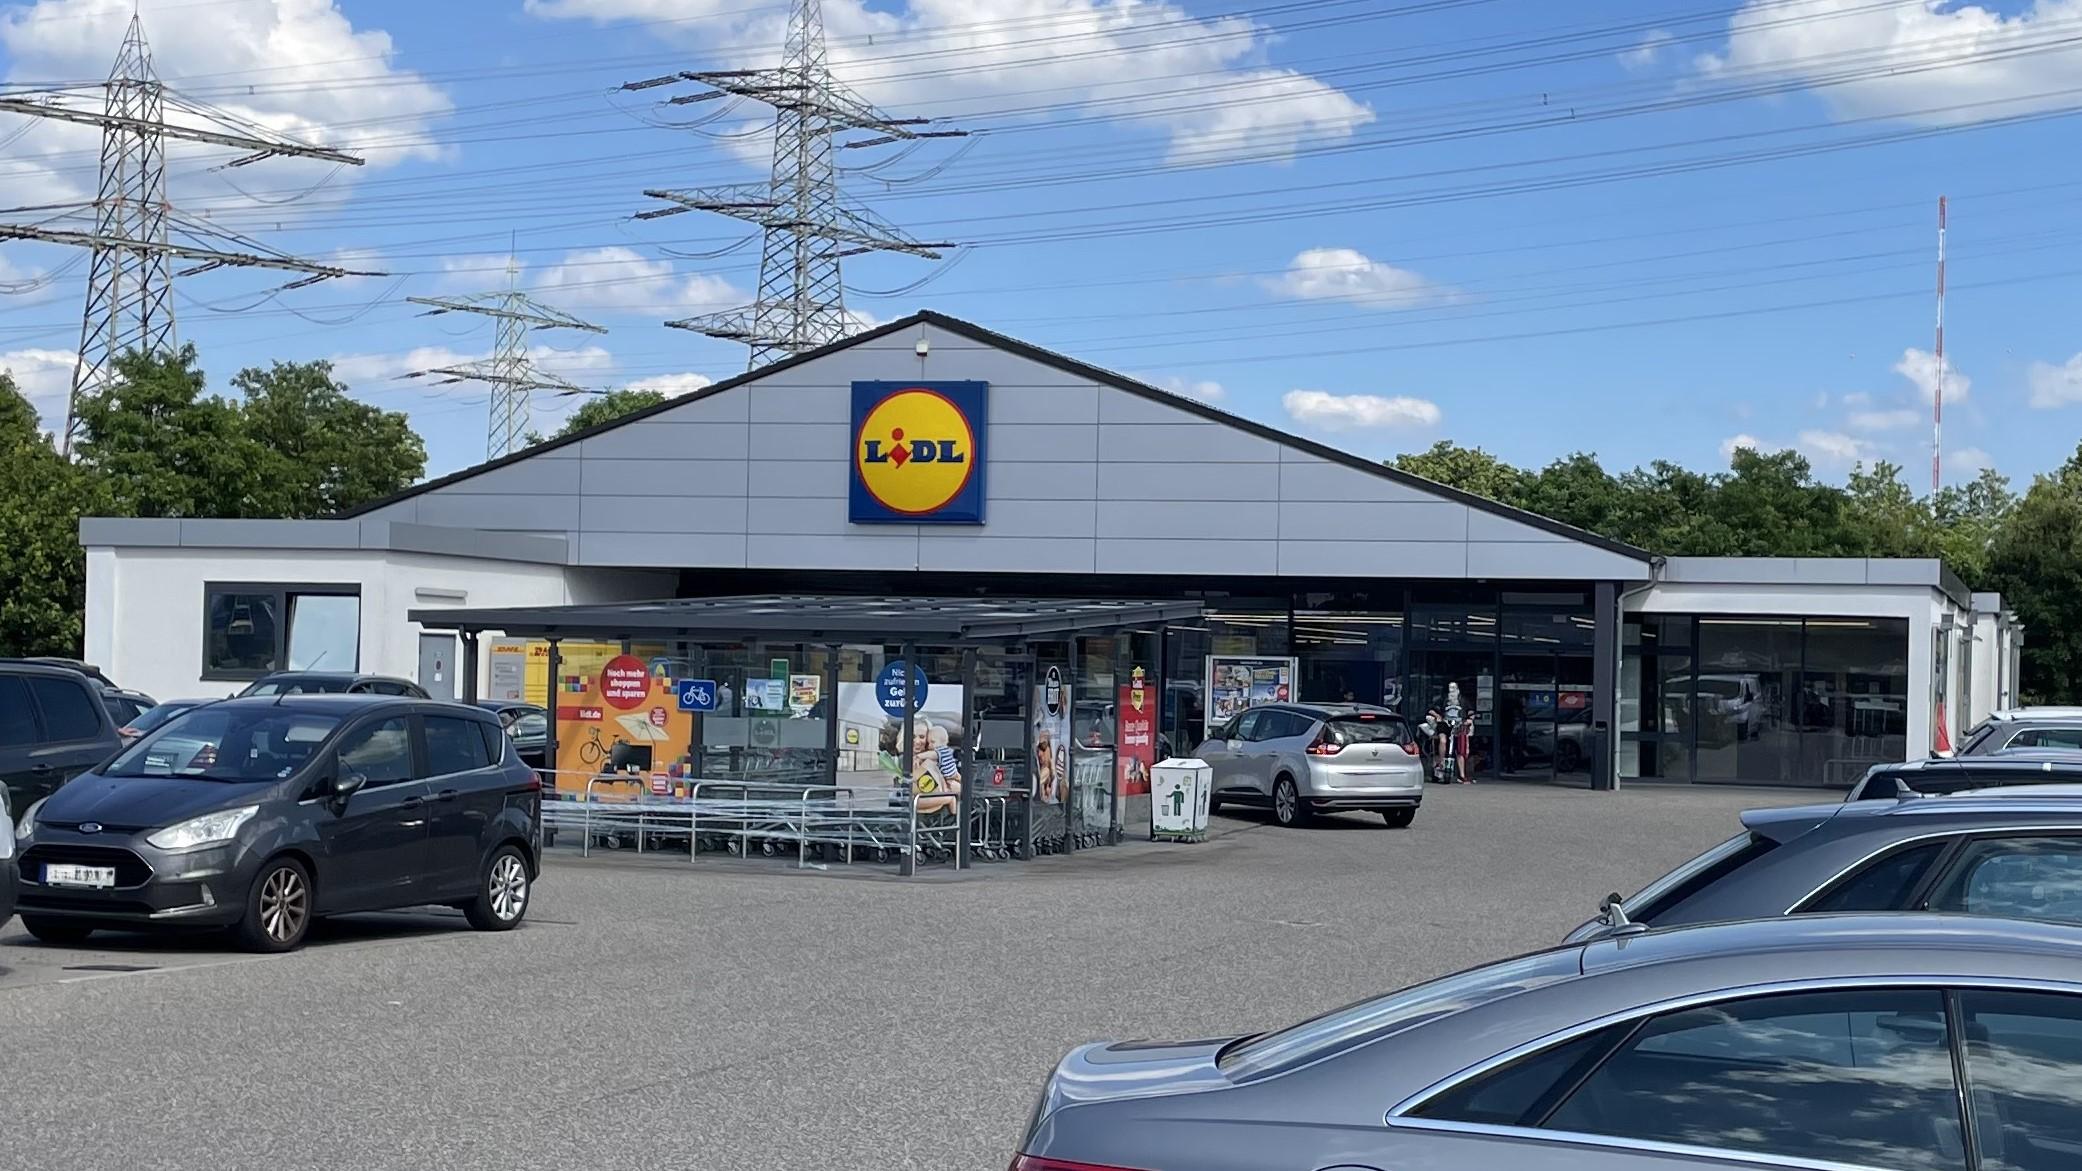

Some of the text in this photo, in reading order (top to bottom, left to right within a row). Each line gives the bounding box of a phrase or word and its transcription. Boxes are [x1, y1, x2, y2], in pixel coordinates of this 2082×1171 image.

[864, 427, 964, 469] LIDL
[606, 668, 645, 678] Noch mehr
[610, 678, 641, 689] shoppen
[606, 688, 646, 700] und sparen
[884, 697, 919, 708] zurük
